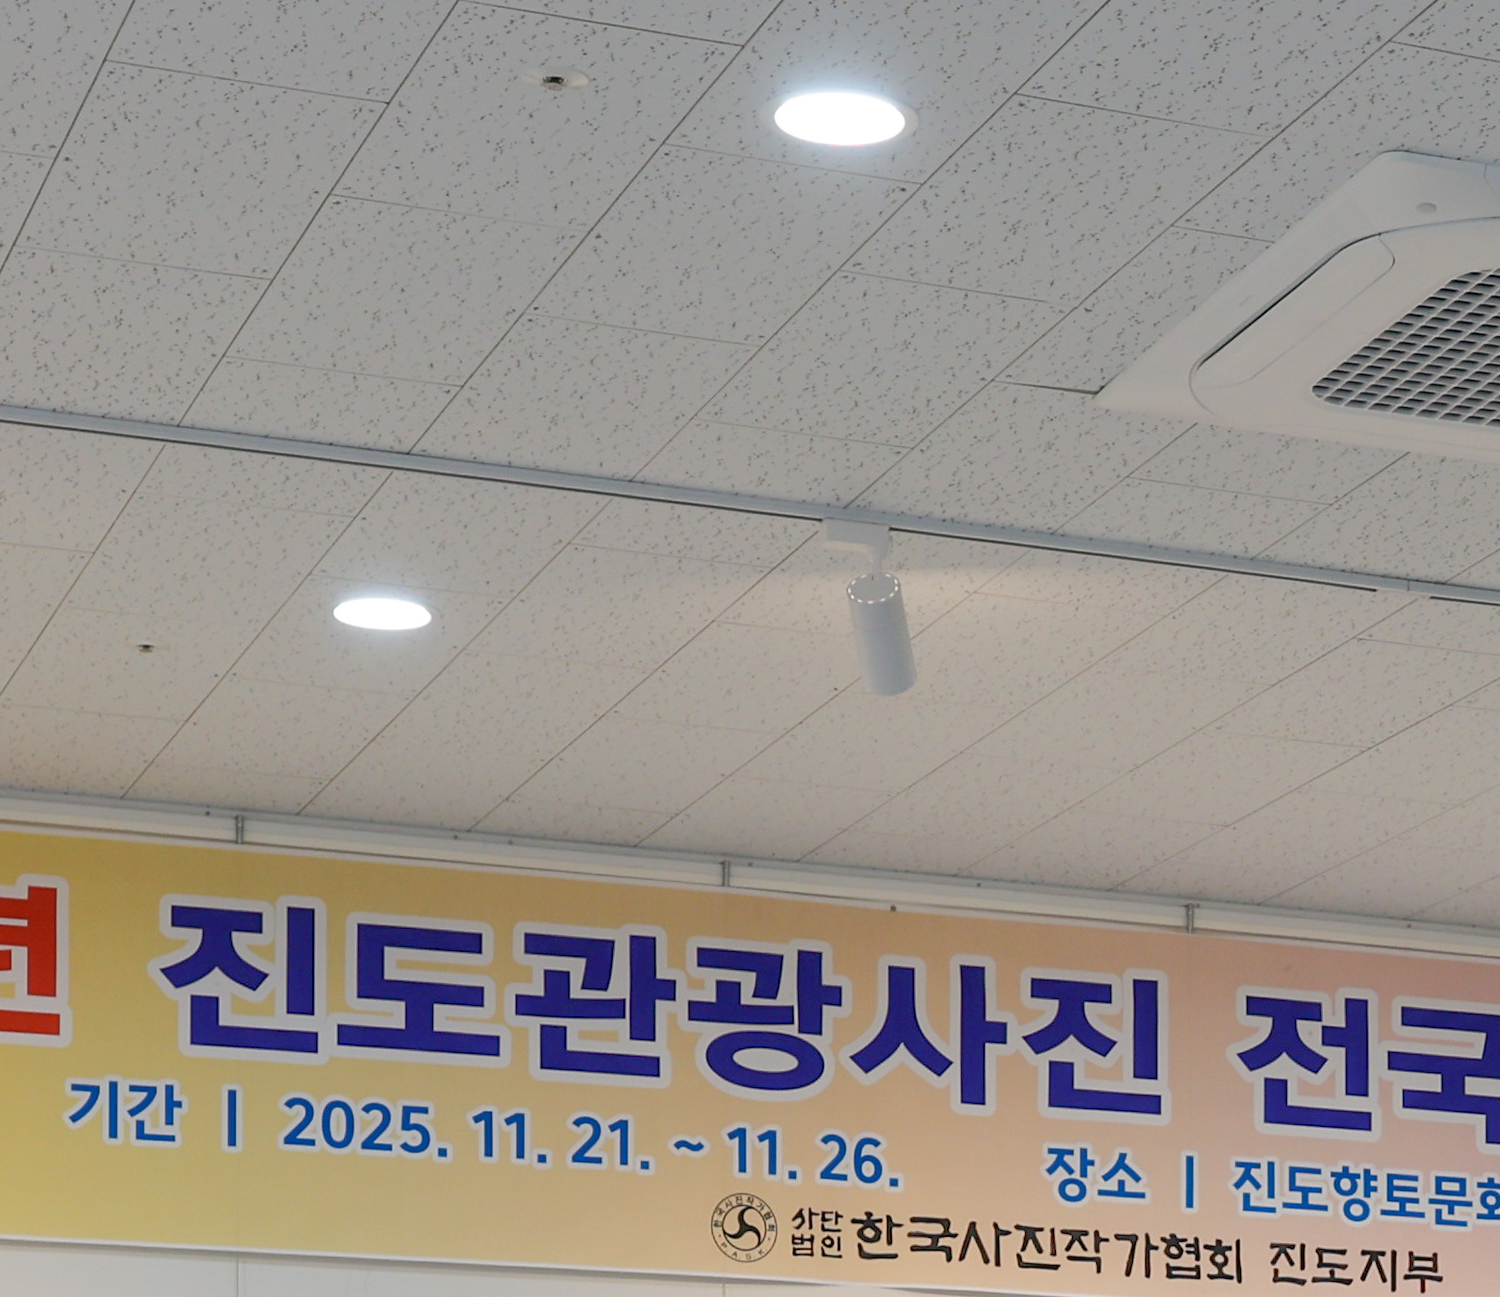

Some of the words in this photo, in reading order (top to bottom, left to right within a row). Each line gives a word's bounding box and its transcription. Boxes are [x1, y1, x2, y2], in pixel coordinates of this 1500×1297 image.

[160, 904, 1162, 1114] 진도관광사진
[69, 1081, 183, 1143] 기간
[283, 1097, 449, 1158] 2025.
[1045, 1147, 1147, 1203] 장소
[791, 1234, 843, 1259] 법인
[850, 1211, 1243, 1284] 한국사진작가협회
[1269, 1239, 1444, 1294] 진도지부
